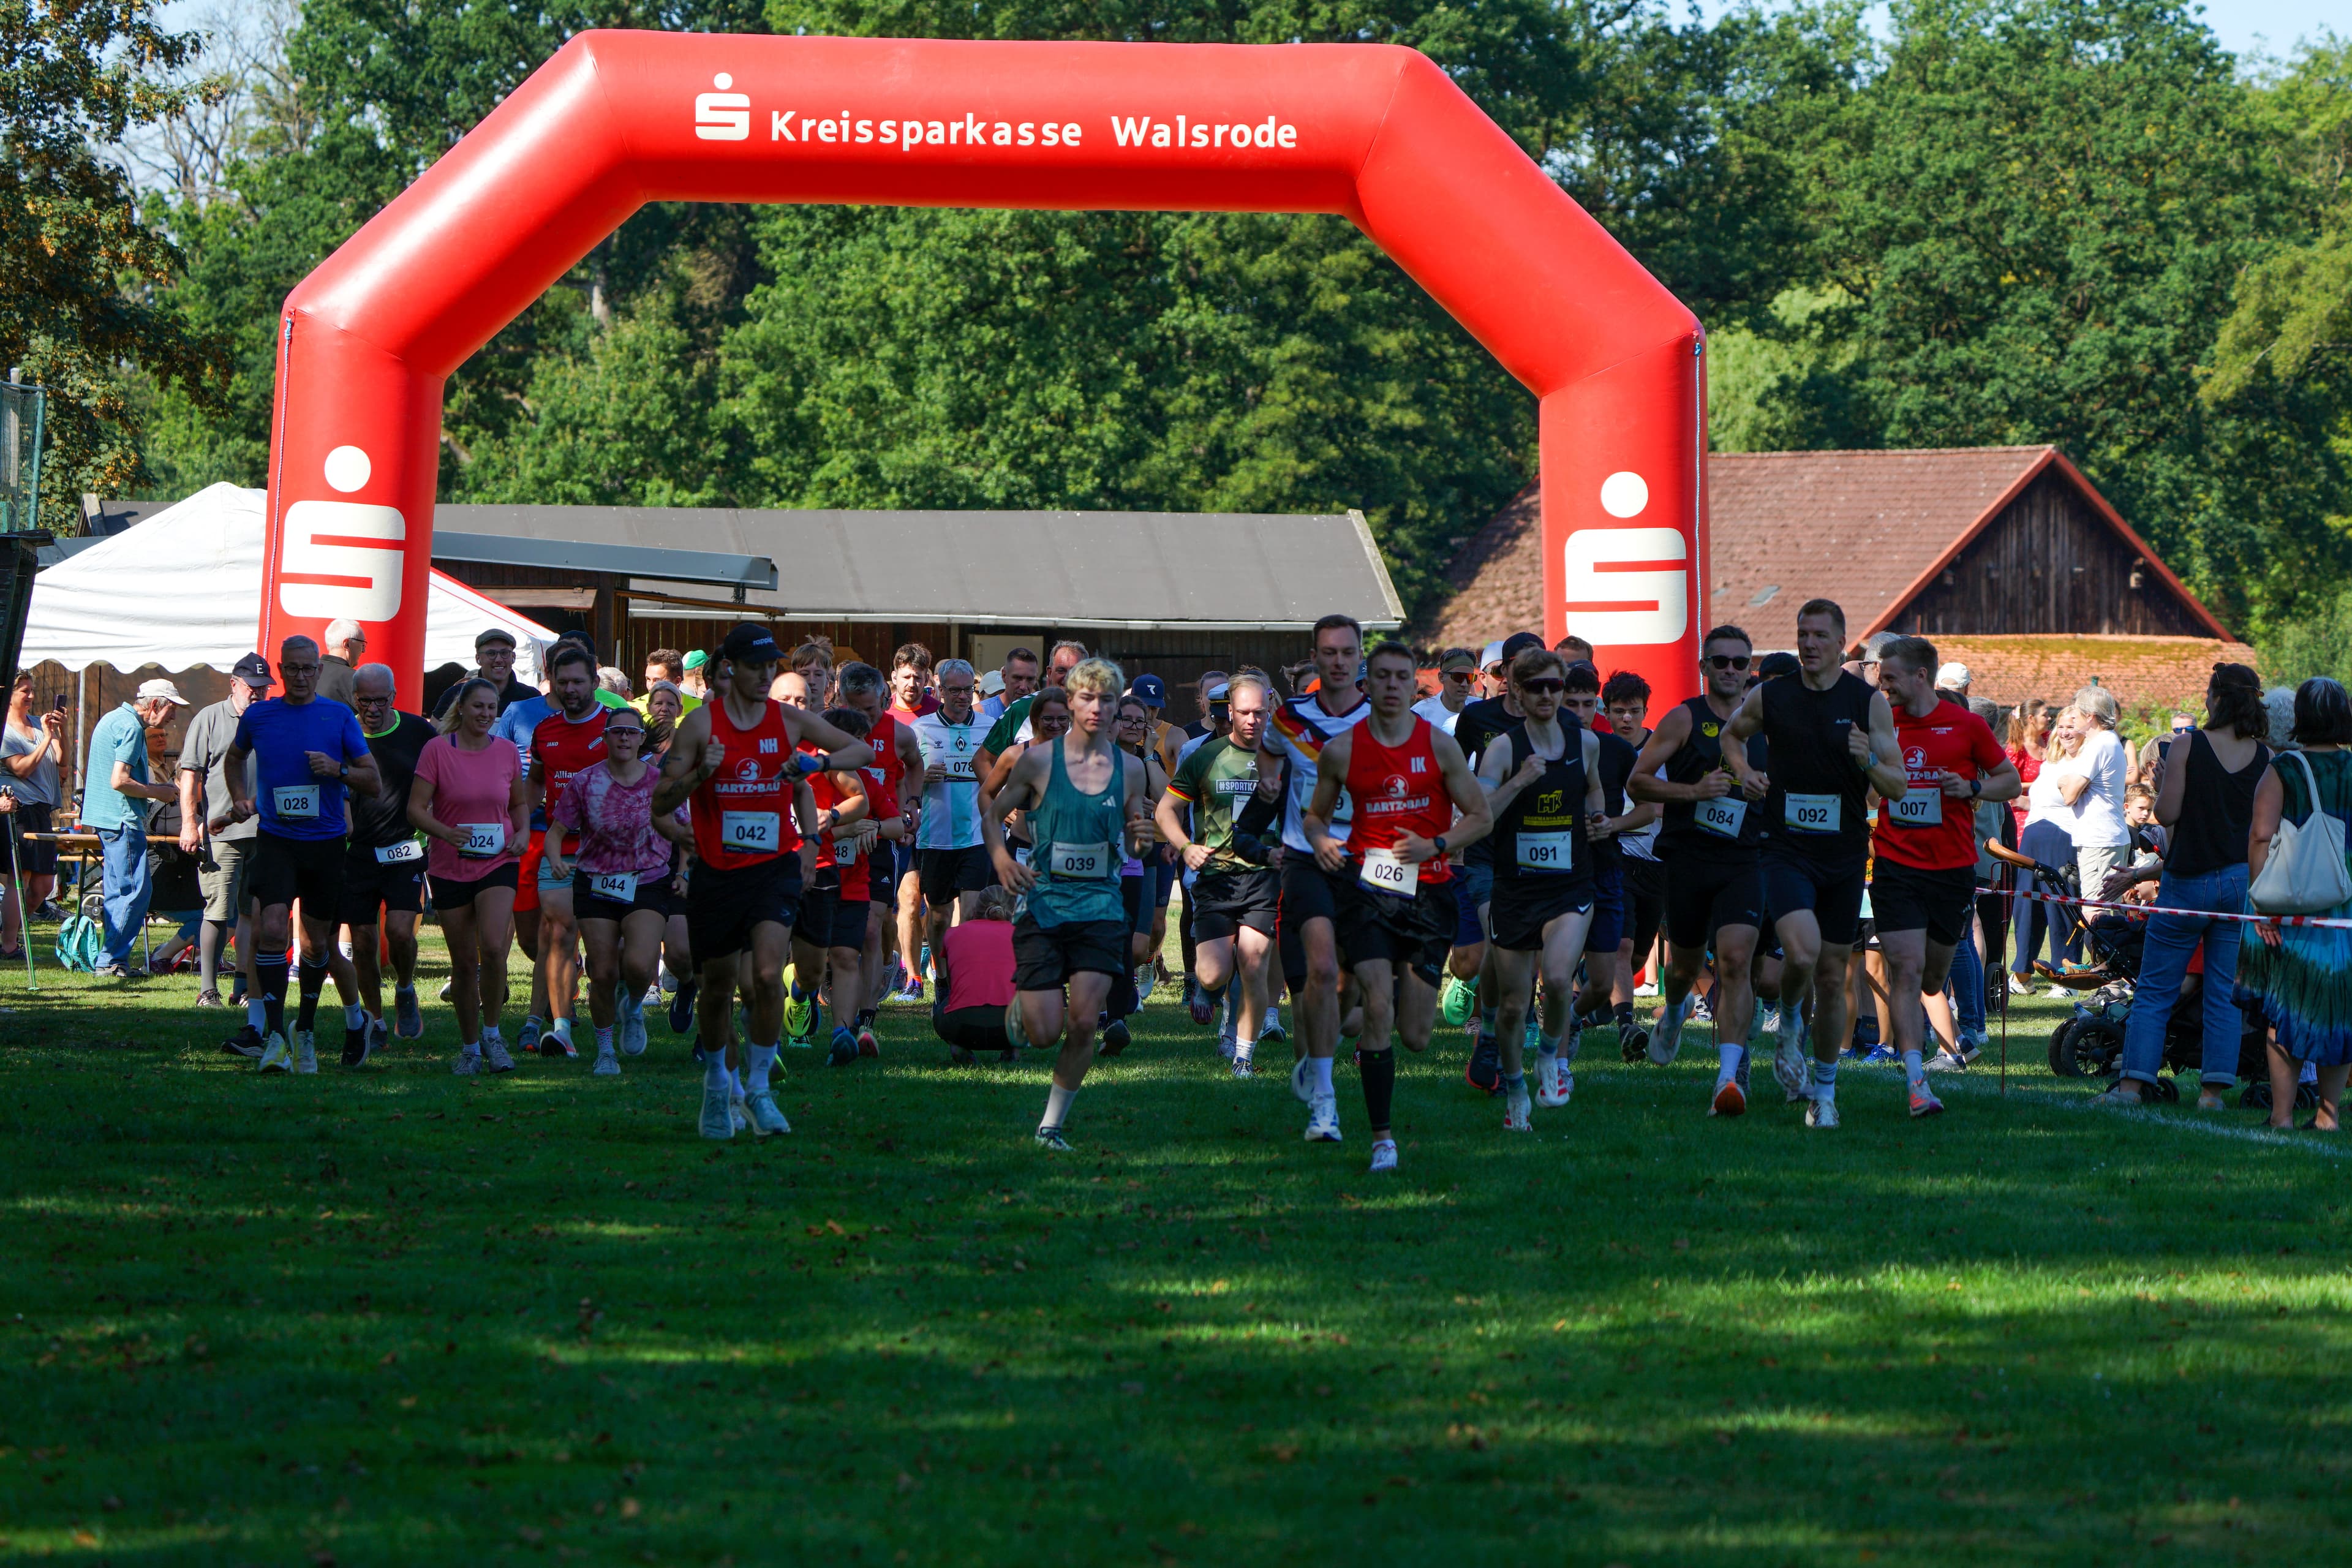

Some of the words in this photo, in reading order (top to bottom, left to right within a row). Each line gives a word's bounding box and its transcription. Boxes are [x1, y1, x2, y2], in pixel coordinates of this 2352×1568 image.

[772, 111, 1081, 150] Kreissparkasse
[1112, 115, 1296, 147] Walsrode
[256, 663, 264, 674] E
[759, 737, 778, 754] NH
[873, 739, 884, 752] TS
[1411, 756, 1427, 773] IK
[1906, 771, 1939, 780] TZ•BA
[1219, 782, 1257, 791] #SPORTKA
[284, 797, 309, 810] 028
[1901, 802, 1928, 815] 007
[1707, 808, 1734, 826] 084
[1798, 809, 1827, 823] 092
[736, 826, 766, 840] 042
[470, 835, 494, 848] 024
[387, 845, 412, 859] 082
[834, 846, 848, 858] 48
[1529, 846, 1556, 861] 091
[1066, 858, 1095, 871] 039
[1375, 864, 1403, 881] 026
[601, 877, 625, 892] 044
